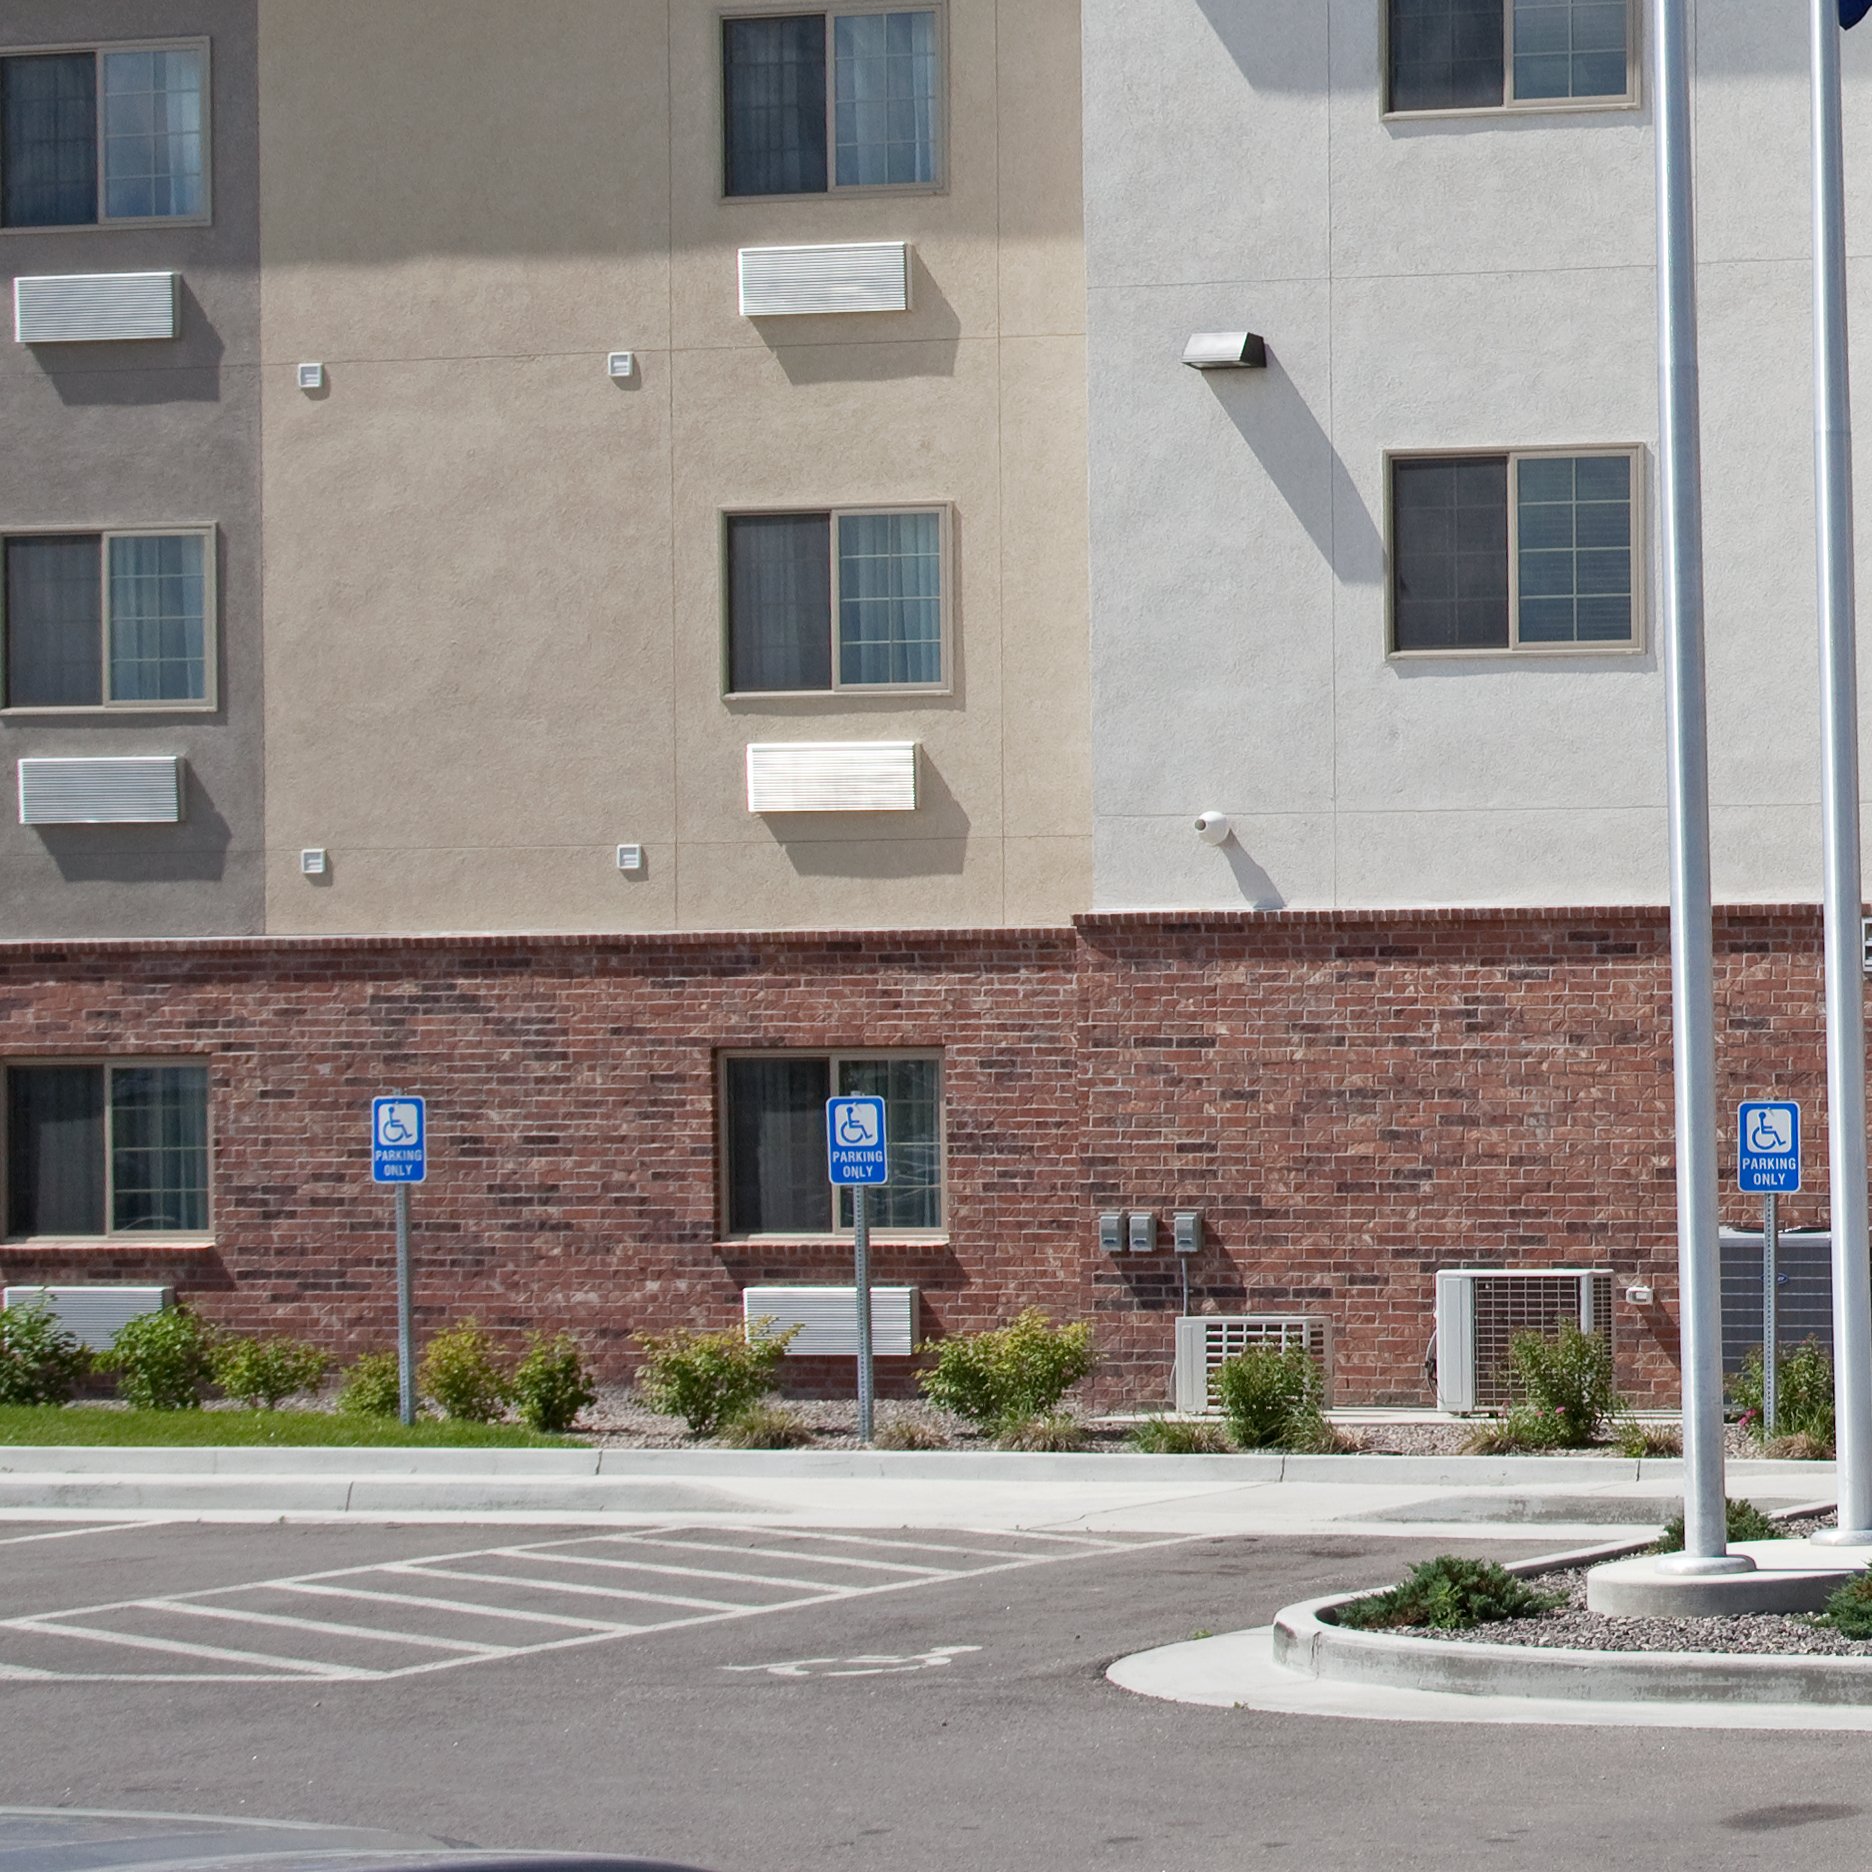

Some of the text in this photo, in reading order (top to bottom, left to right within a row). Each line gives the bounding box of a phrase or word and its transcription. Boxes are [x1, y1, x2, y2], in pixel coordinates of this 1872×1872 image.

[375, 1150, 422, 1161] PARKING
[833, 1151, 883, 1162] PARKING
[1743, 1158, 1796, 1169] PARKING
[384, 1164, 413, 1176] ONLY
[843, 1166, 873, 1178] ONLY
[1753, 1173, 1785, 1185] ONLY
